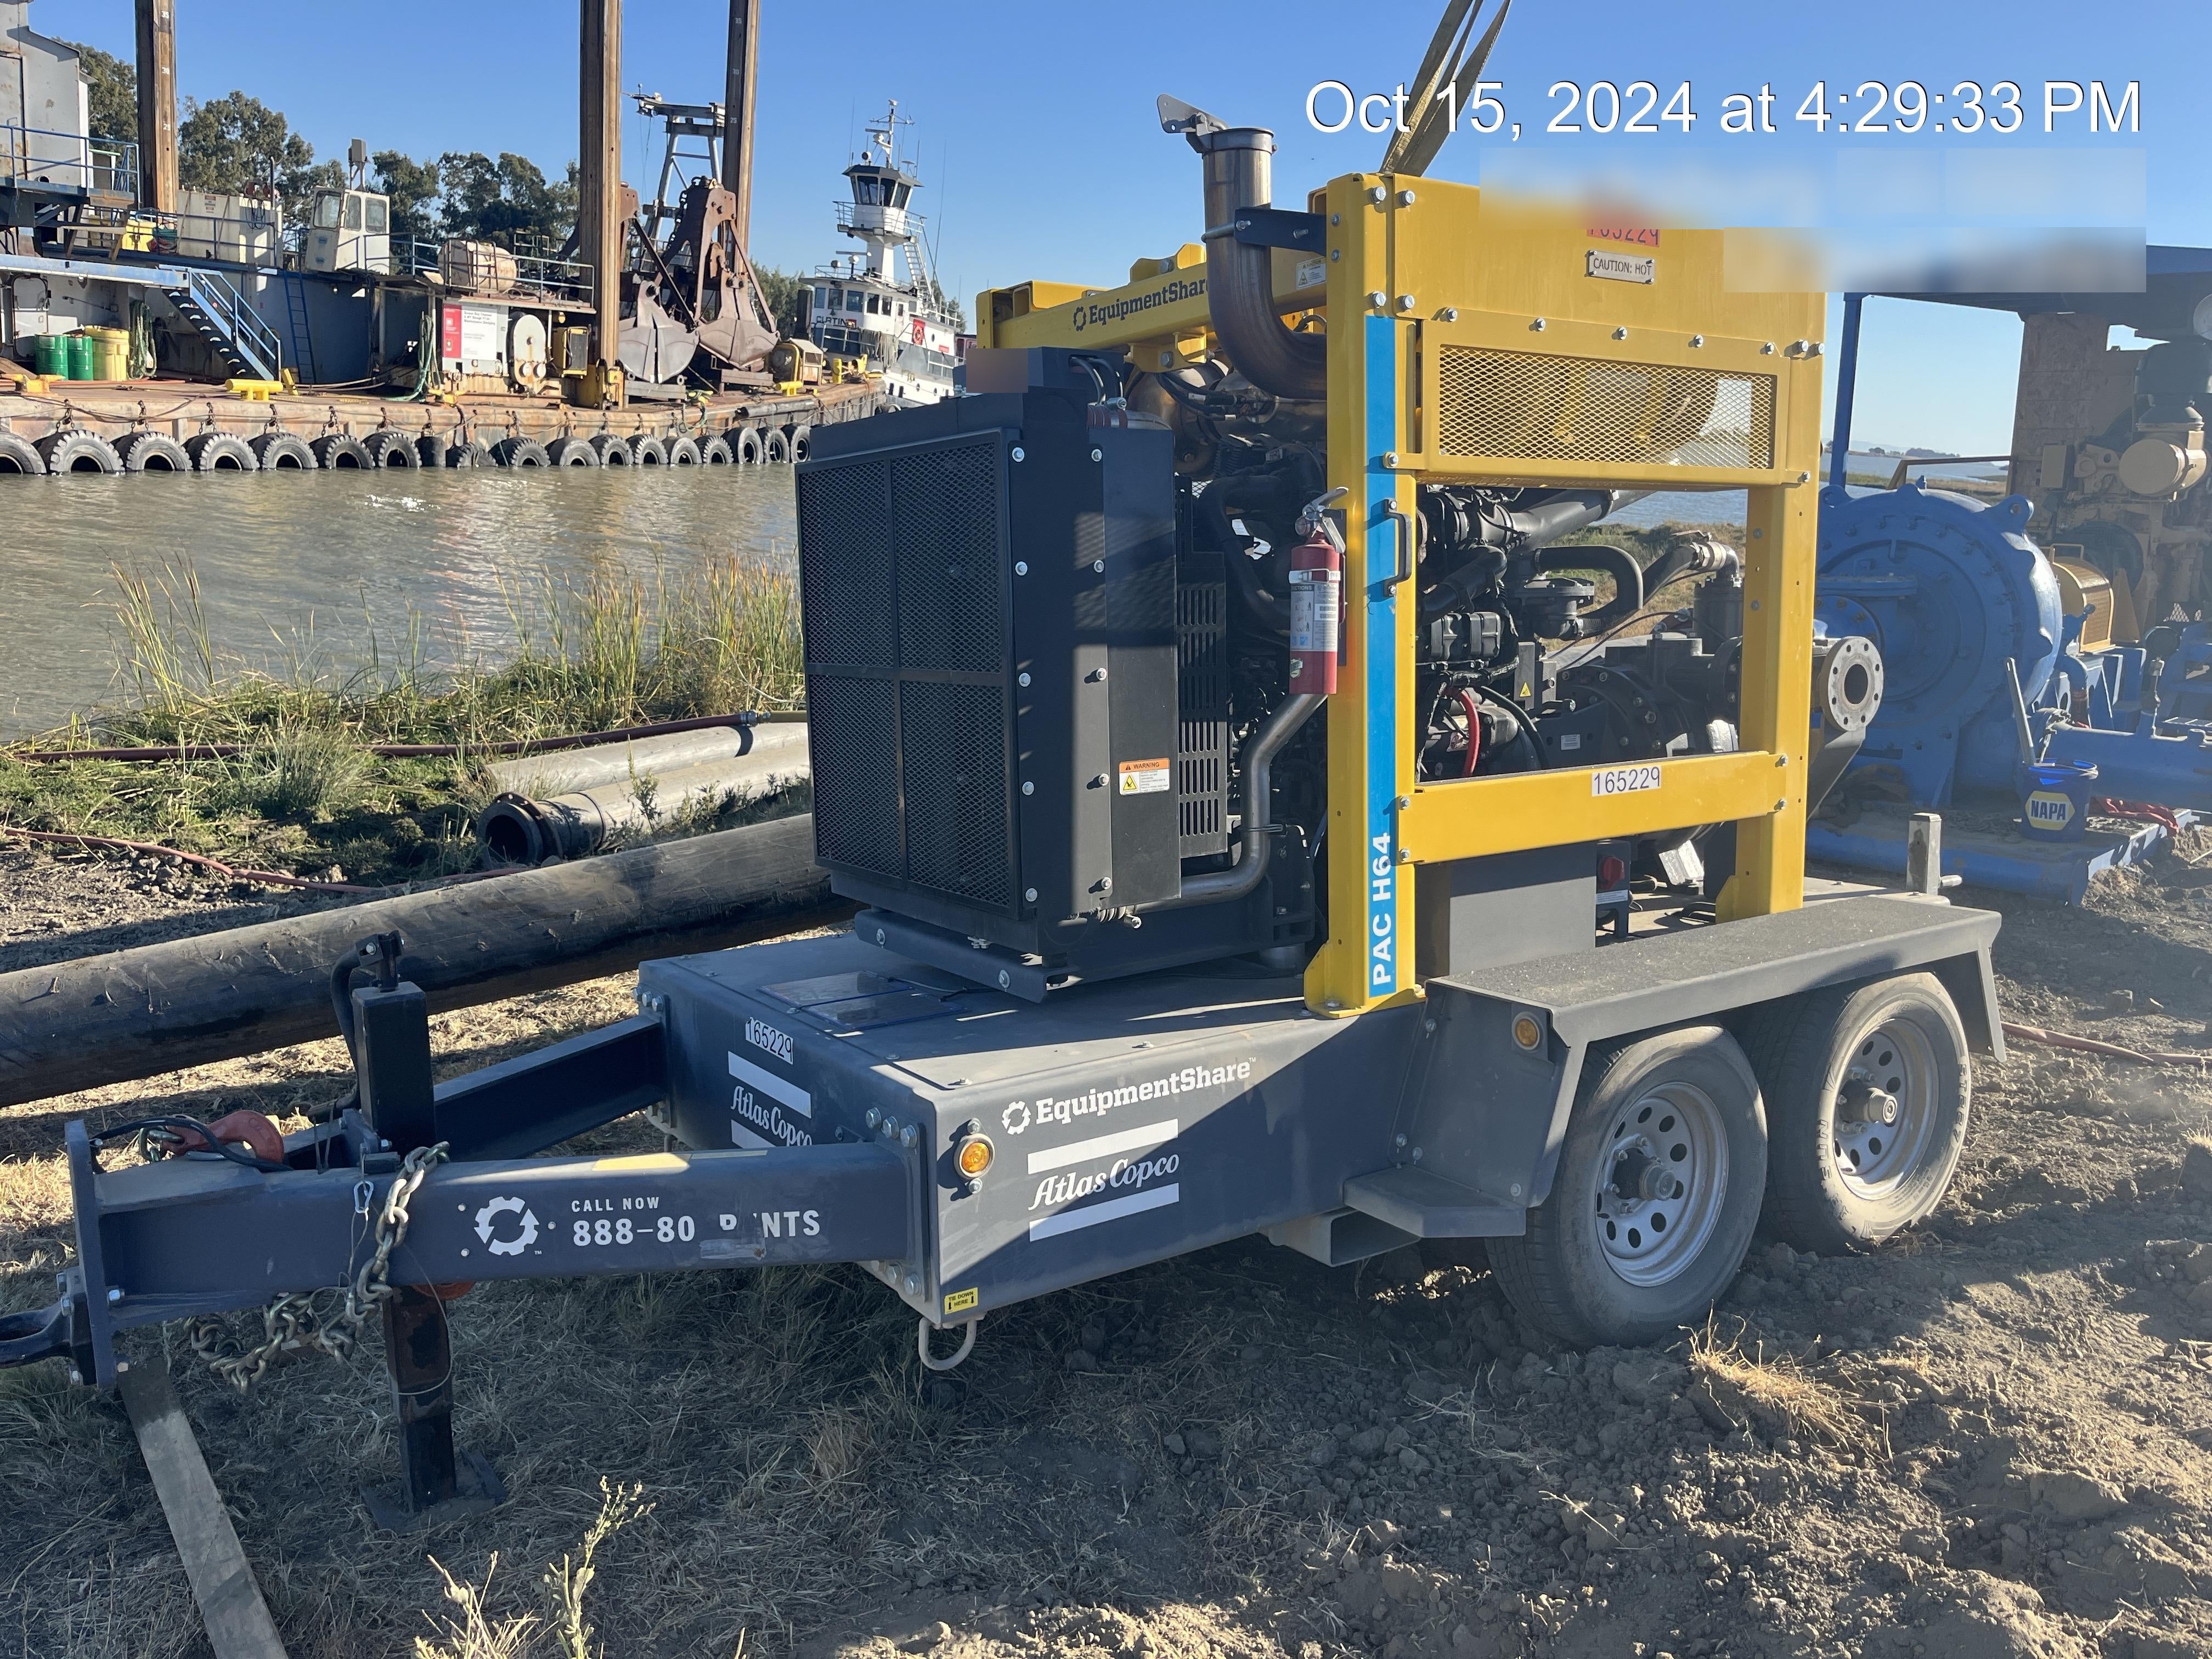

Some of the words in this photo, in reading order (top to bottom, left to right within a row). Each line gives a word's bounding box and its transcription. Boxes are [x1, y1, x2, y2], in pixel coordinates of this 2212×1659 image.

[161, 10, 169, 19] 35
[163, 123, 171, 131] 25
[1593, 258, 1632, 273] CAUTION:
[1635, 263, 1652, 276] HOT
[1089, 278, 1207, 325] EquipmentShar
[1594, 766, 1660, 794] 165229
[2031, 800, 2066, 821] NAPA
[1373, 832, 1391, 901] H64
[1373, 913, 1392, 985] PAC
[747, 1019, 792, 1062] 165229
[1036, 1061, 1251, 1125] EquipmentShare
[731, 1086, 770, 1130] Atlas
[1028, 1172, 1107, 1211] Atlas
[1109, 1154, 1180, 1188] Copco
[572, 1199, 613, 1212] CALL
[623, 1197, 659, 1210] NOW
[573, 1215, 695, 1246] 888-80
[954, 1299, 968, 1307] HERE
[957, 1291, 974, 1299] DOWN
